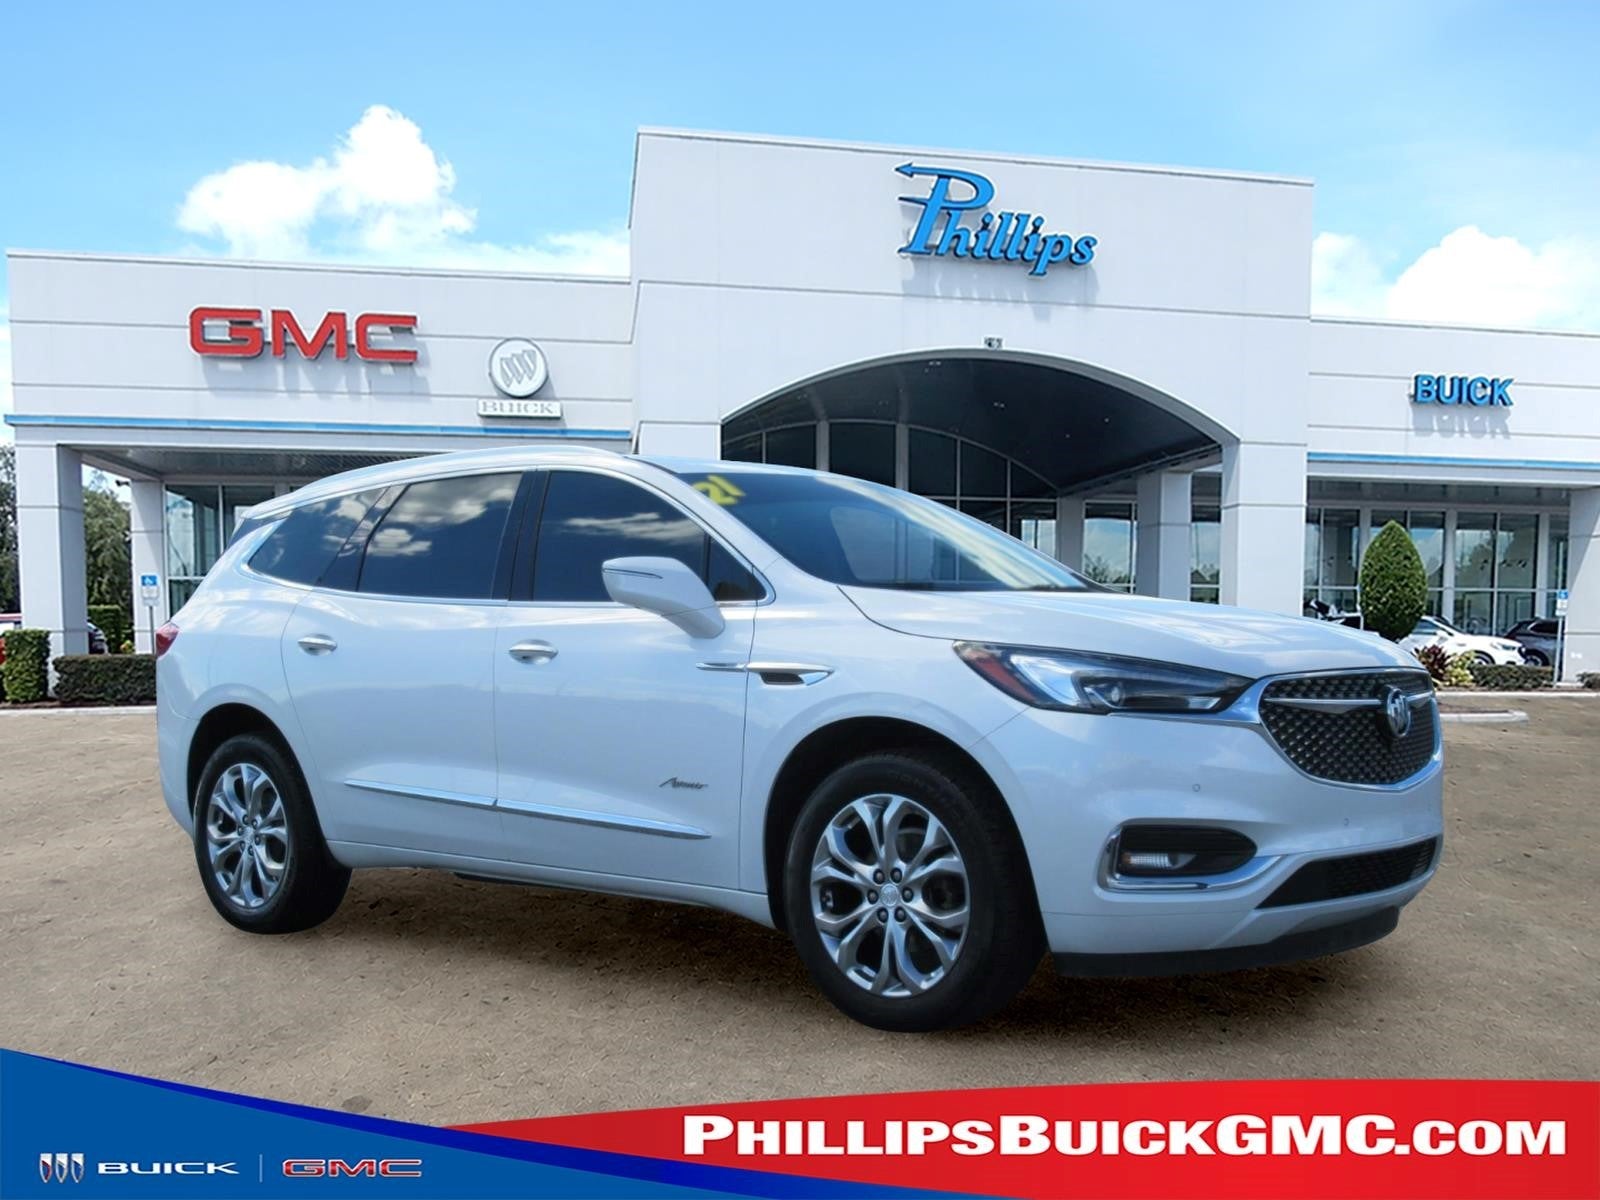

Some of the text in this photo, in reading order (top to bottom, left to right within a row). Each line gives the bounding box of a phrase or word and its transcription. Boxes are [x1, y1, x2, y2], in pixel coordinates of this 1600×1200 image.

[894, 162, 1098, 276] Phillips
[189, 306, 418, 364] GMC
[482, 401, 555, 413] BUICK
[1414, 374, 1513, 406] BUICK
